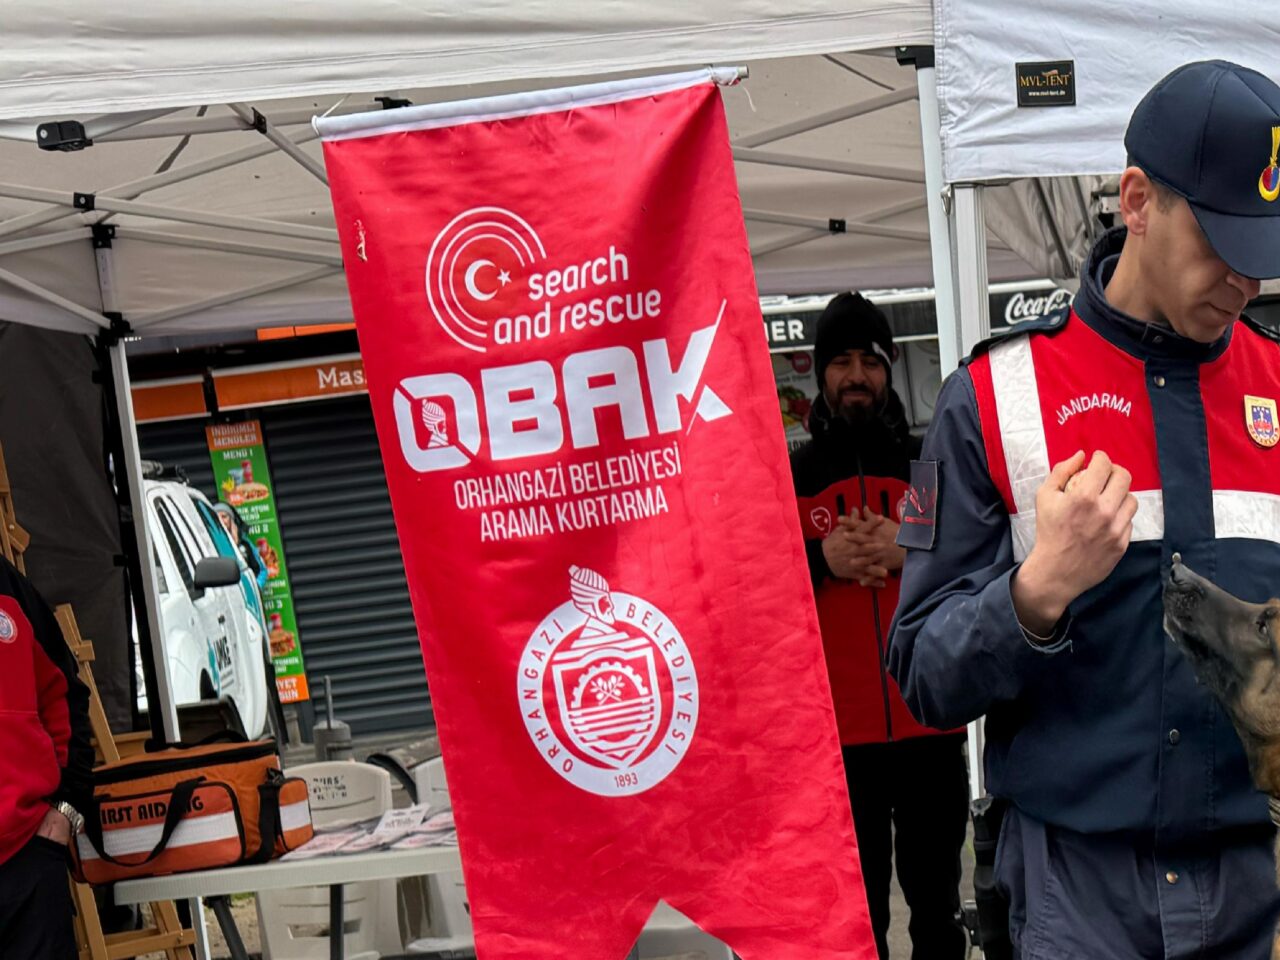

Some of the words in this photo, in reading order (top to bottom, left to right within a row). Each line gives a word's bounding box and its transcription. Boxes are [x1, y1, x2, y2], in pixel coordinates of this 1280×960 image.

[528, 245, 629, 301] search
[493, 301, 551, 345] and
[559, 288, 662, 335] rescue
[393, 299, 734, 474] OBAK
[1056, 392, 1133, 427] JANDARMA
[453, 461, 566, 511] ORHANGAZİ
[569, 441, 682, 495] BELEDİYESİ
[480, 504, 555, 543] ARAMA
[555, 485, 670, 533] KURTARMA
[613, 772, 639, 788] 1893
[101, 804, 134, 825] IRST
[138, 803, 167, 821] AID
